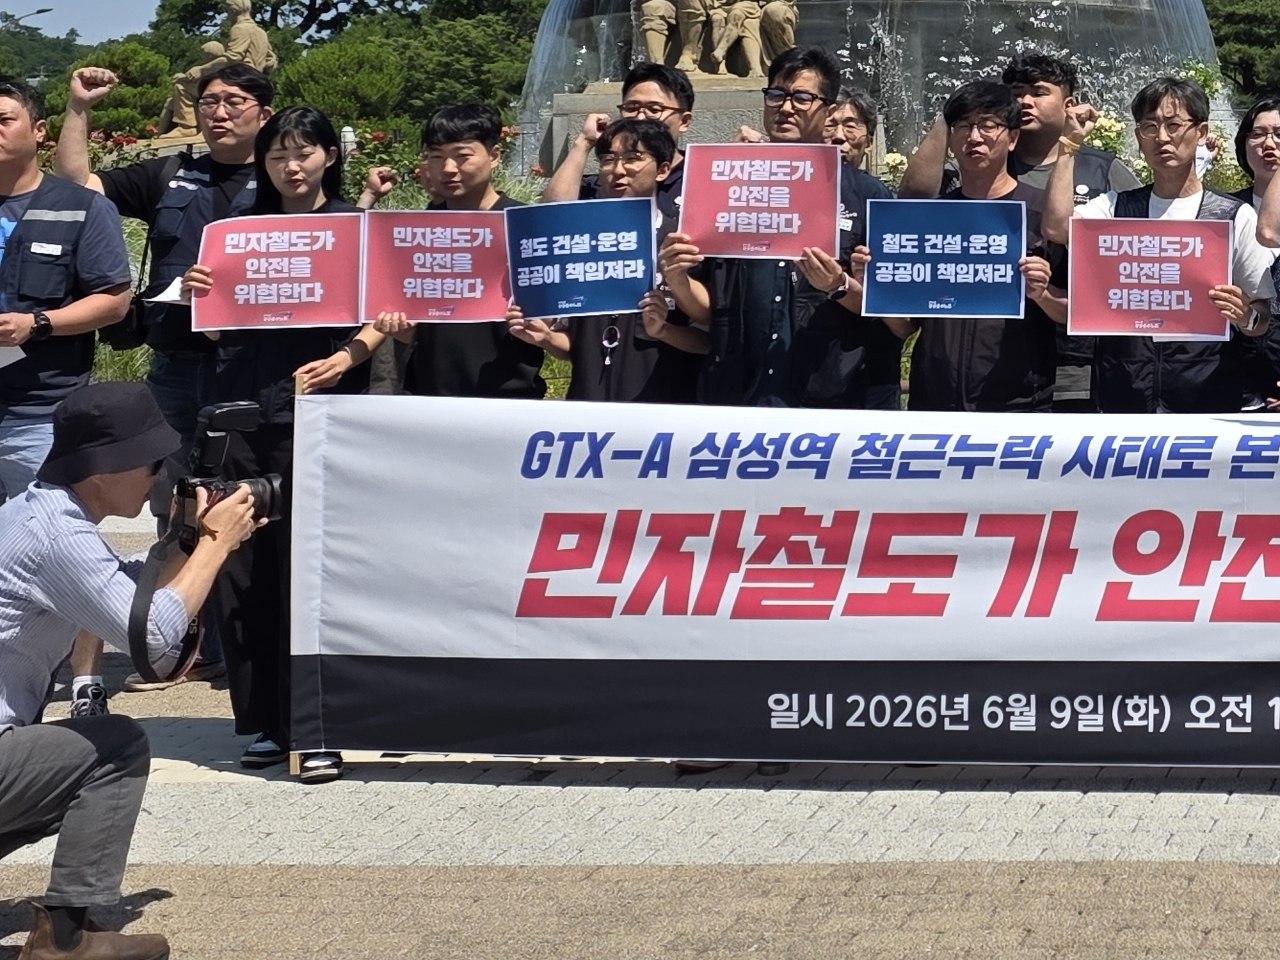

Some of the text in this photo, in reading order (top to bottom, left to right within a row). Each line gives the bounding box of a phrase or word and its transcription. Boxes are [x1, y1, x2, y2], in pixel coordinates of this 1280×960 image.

[711, 160, 814, 182] 민자철도가
[728, 186, 790, 208] 안전을
[715, 212, 801, 234] 위협한다
[224, 230, 335, 254] 민자철도가
[393, 227, 493, 248] 민자철도가
[520, 236, 548, 258] 철도
[882, 233, 919, 254] 철도
[1098, 235, 1204, 258] 민자철도가
[246, 256, 312, 278] 안전을
[412, 252, 472, 272] 안전을
[517, 260, 646, 286] 공공이 책임져라
[875, 262, 1014, 284] 공공이 책임져라
[1119, 262, 1180, 284] 안전을
[234, 282, 324, 304] 위협한다
[403, 278, 484, 298] 위협한다
[1108, 289, 1192, 311] 위협한다
[520, 431, 674, 480] GTX-A
[686, 432, 840, 480] 삼성역
[848, 432, 1054, 480] 철근누락
[1060, 434, 1216, 480] 사태로
[515, 506, 1079, 620] 민자철도가
[767, 693, 834, 730] 일시
[845, 693, 970, 731] 2026년
[982, 693, 1037, 732] 6월
[1050, 694, 1172, 733] 9일(화)
[1184, 694, 1252, 733] 오전
